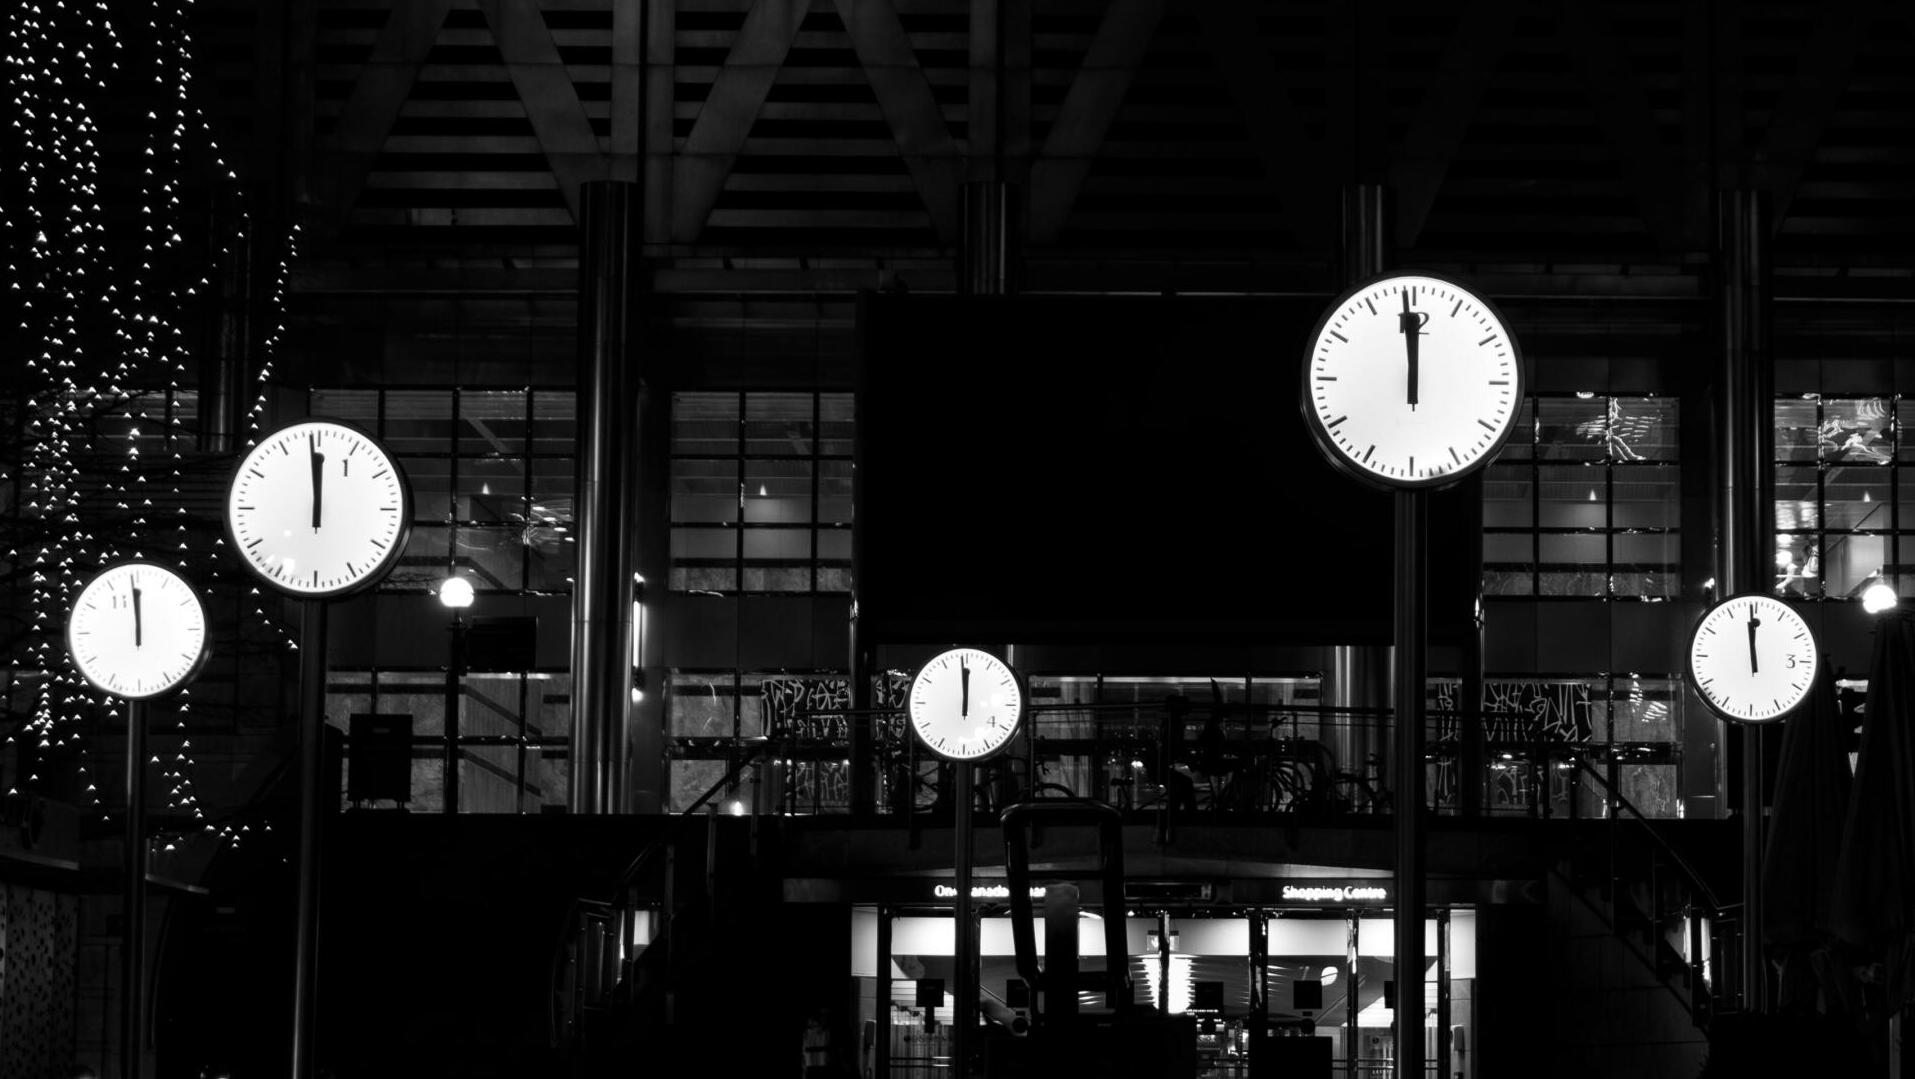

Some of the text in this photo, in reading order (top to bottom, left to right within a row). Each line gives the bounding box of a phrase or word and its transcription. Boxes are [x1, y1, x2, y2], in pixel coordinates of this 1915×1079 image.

[1398, 311, 1430, 335] 12
[341, 459, 349, 477] 1
[112, 595, 127, 609] 11
[1785, 653, 1796, 669] 3
[986, 716, 996, 728] 4
[970, 884, 1010, 897] anada
[1282, 885, 1387, 901] Shopping Centre
